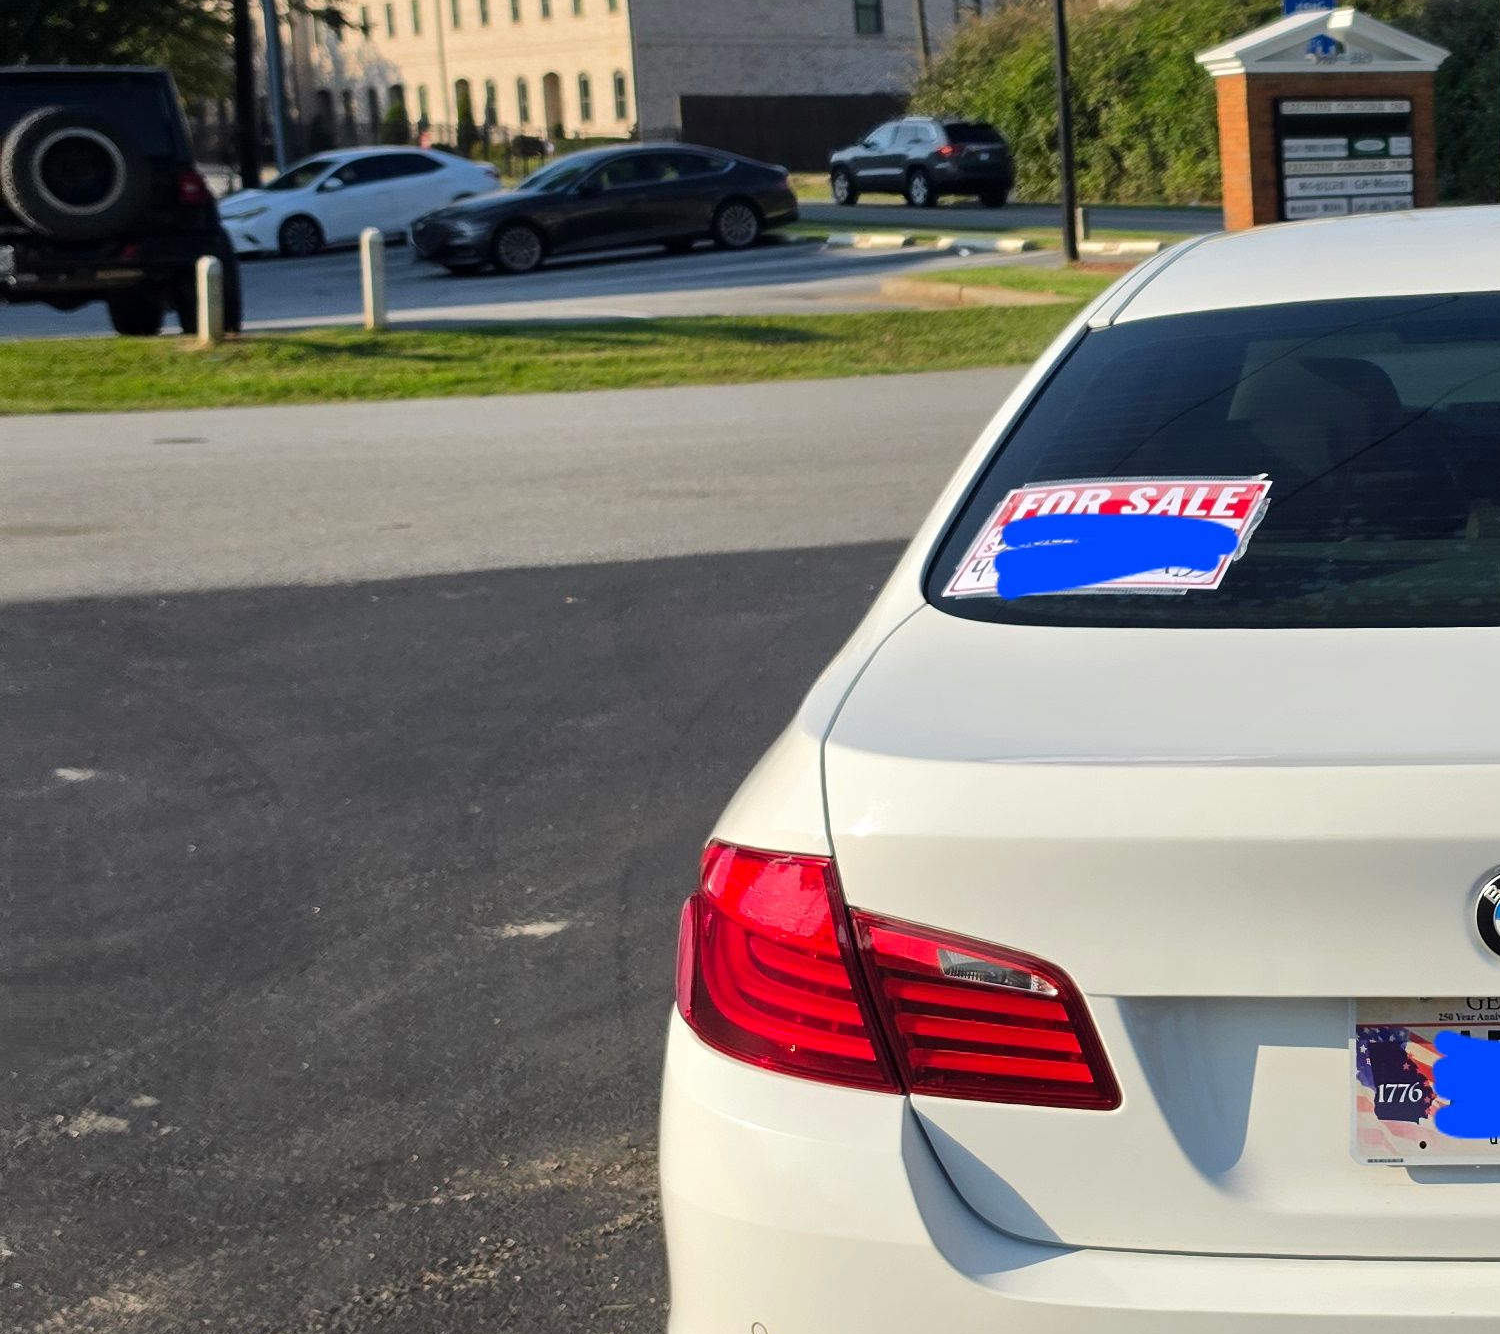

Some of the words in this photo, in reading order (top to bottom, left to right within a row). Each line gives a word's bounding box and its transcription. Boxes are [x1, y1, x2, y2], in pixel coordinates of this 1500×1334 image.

[1012, 489, 1111, 518] FOR
[1119, 486, 1249, 517] SALE
[1438, 1013, 1454, 1021] 250
[1455, 1013, 1475, 1021] Year
[1377, 1082, 1423, 1104] 1776
